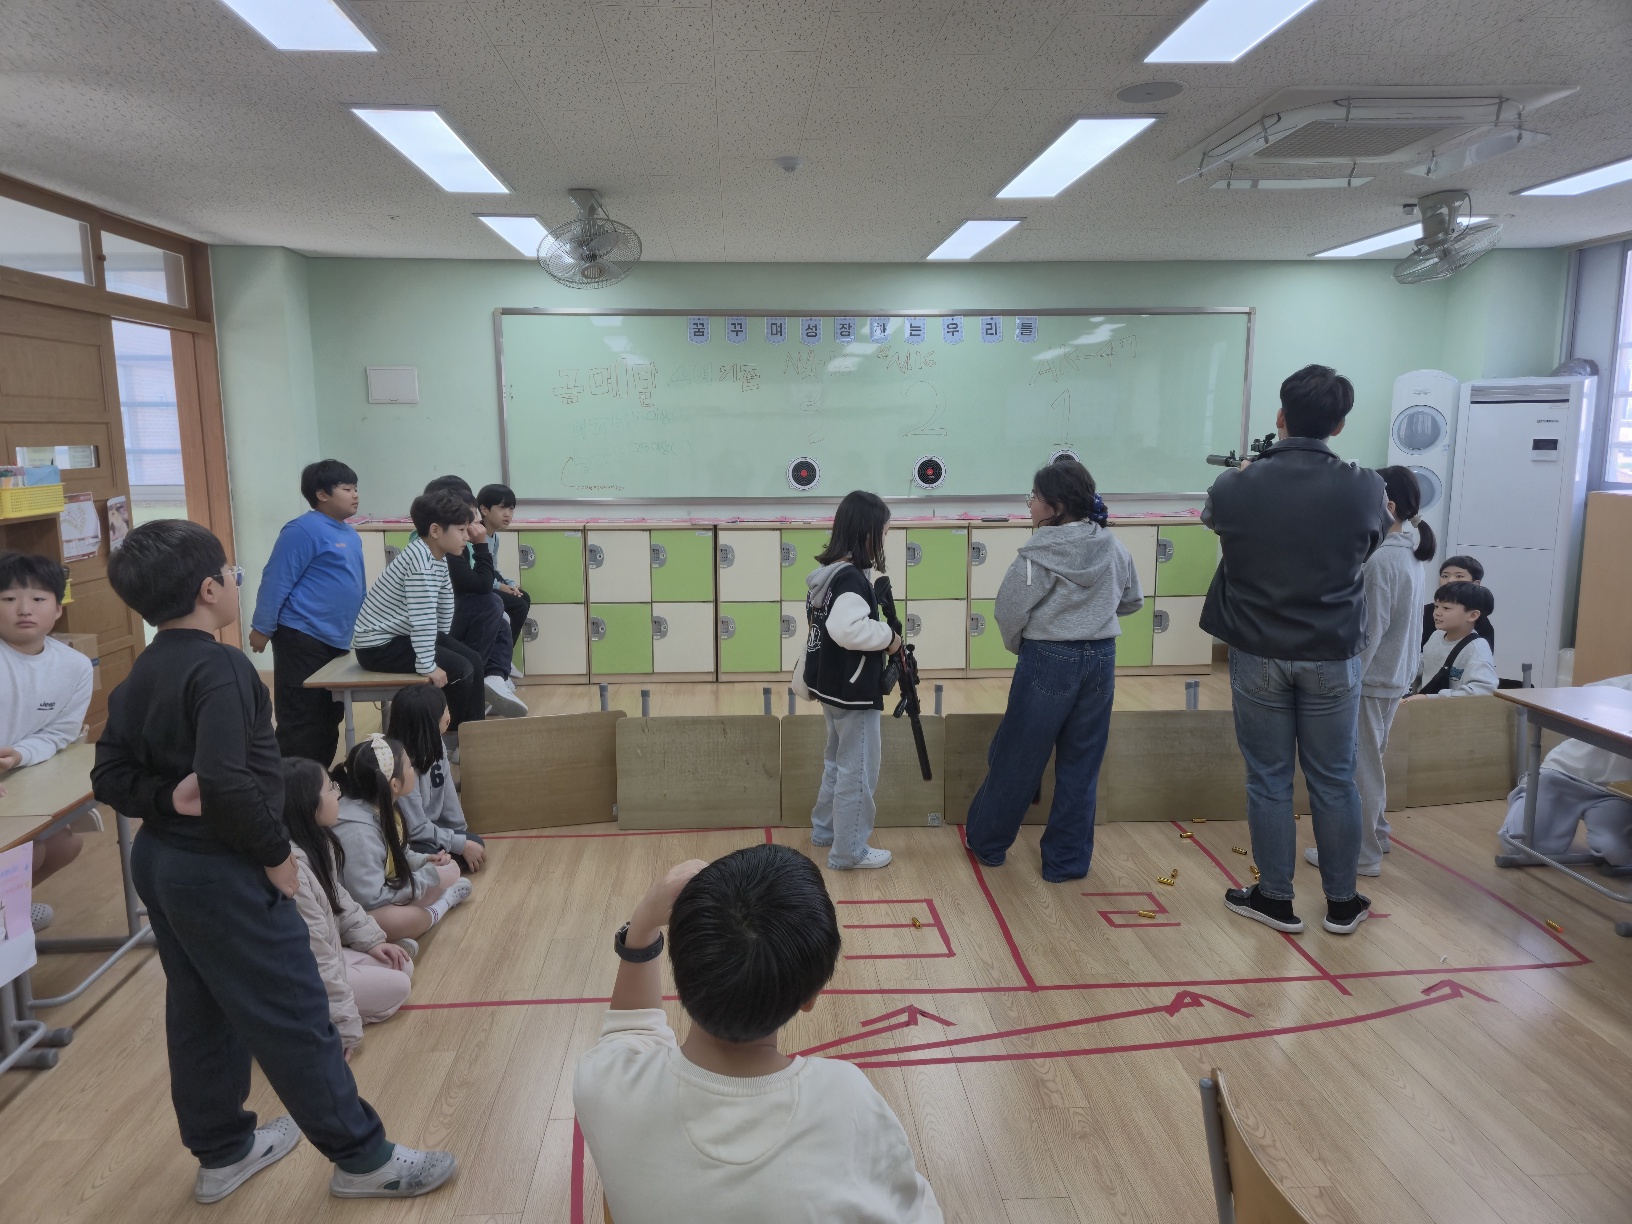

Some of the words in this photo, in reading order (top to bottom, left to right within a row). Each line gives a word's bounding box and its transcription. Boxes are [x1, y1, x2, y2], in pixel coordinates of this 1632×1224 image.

[1028, 333, 1138, 386] AK-47
[899, 375, 948, 438] 2
[1049, 388, 1074, 448] 1
[430, 763, 445, 789] 6
